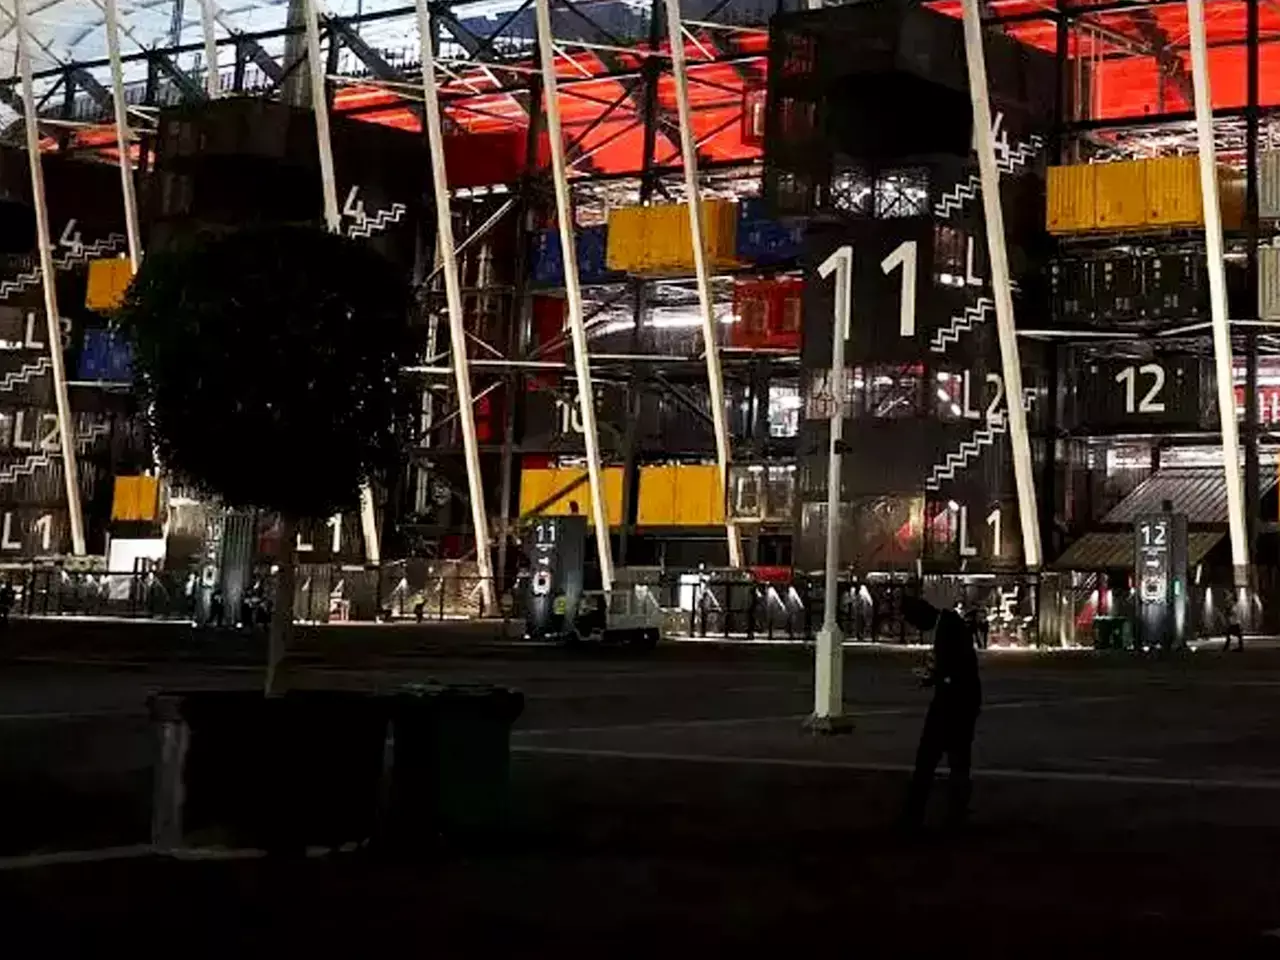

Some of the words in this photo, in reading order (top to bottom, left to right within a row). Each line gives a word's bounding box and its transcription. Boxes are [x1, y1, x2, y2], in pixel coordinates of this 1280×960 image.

[972, 111, 1010, 161] 4
[817, 240, 917, 340] 11
[963, 369, 1005, 421] L2
[1115, 363, 1165, 413] 12
[13, 411, 62, 451] L2
[1, 512, 52, 550] L1
[536, 526, 556, 542] 11
[959, 505, 1001, 556] L1
[1141, 525, 1166, 545] 12
